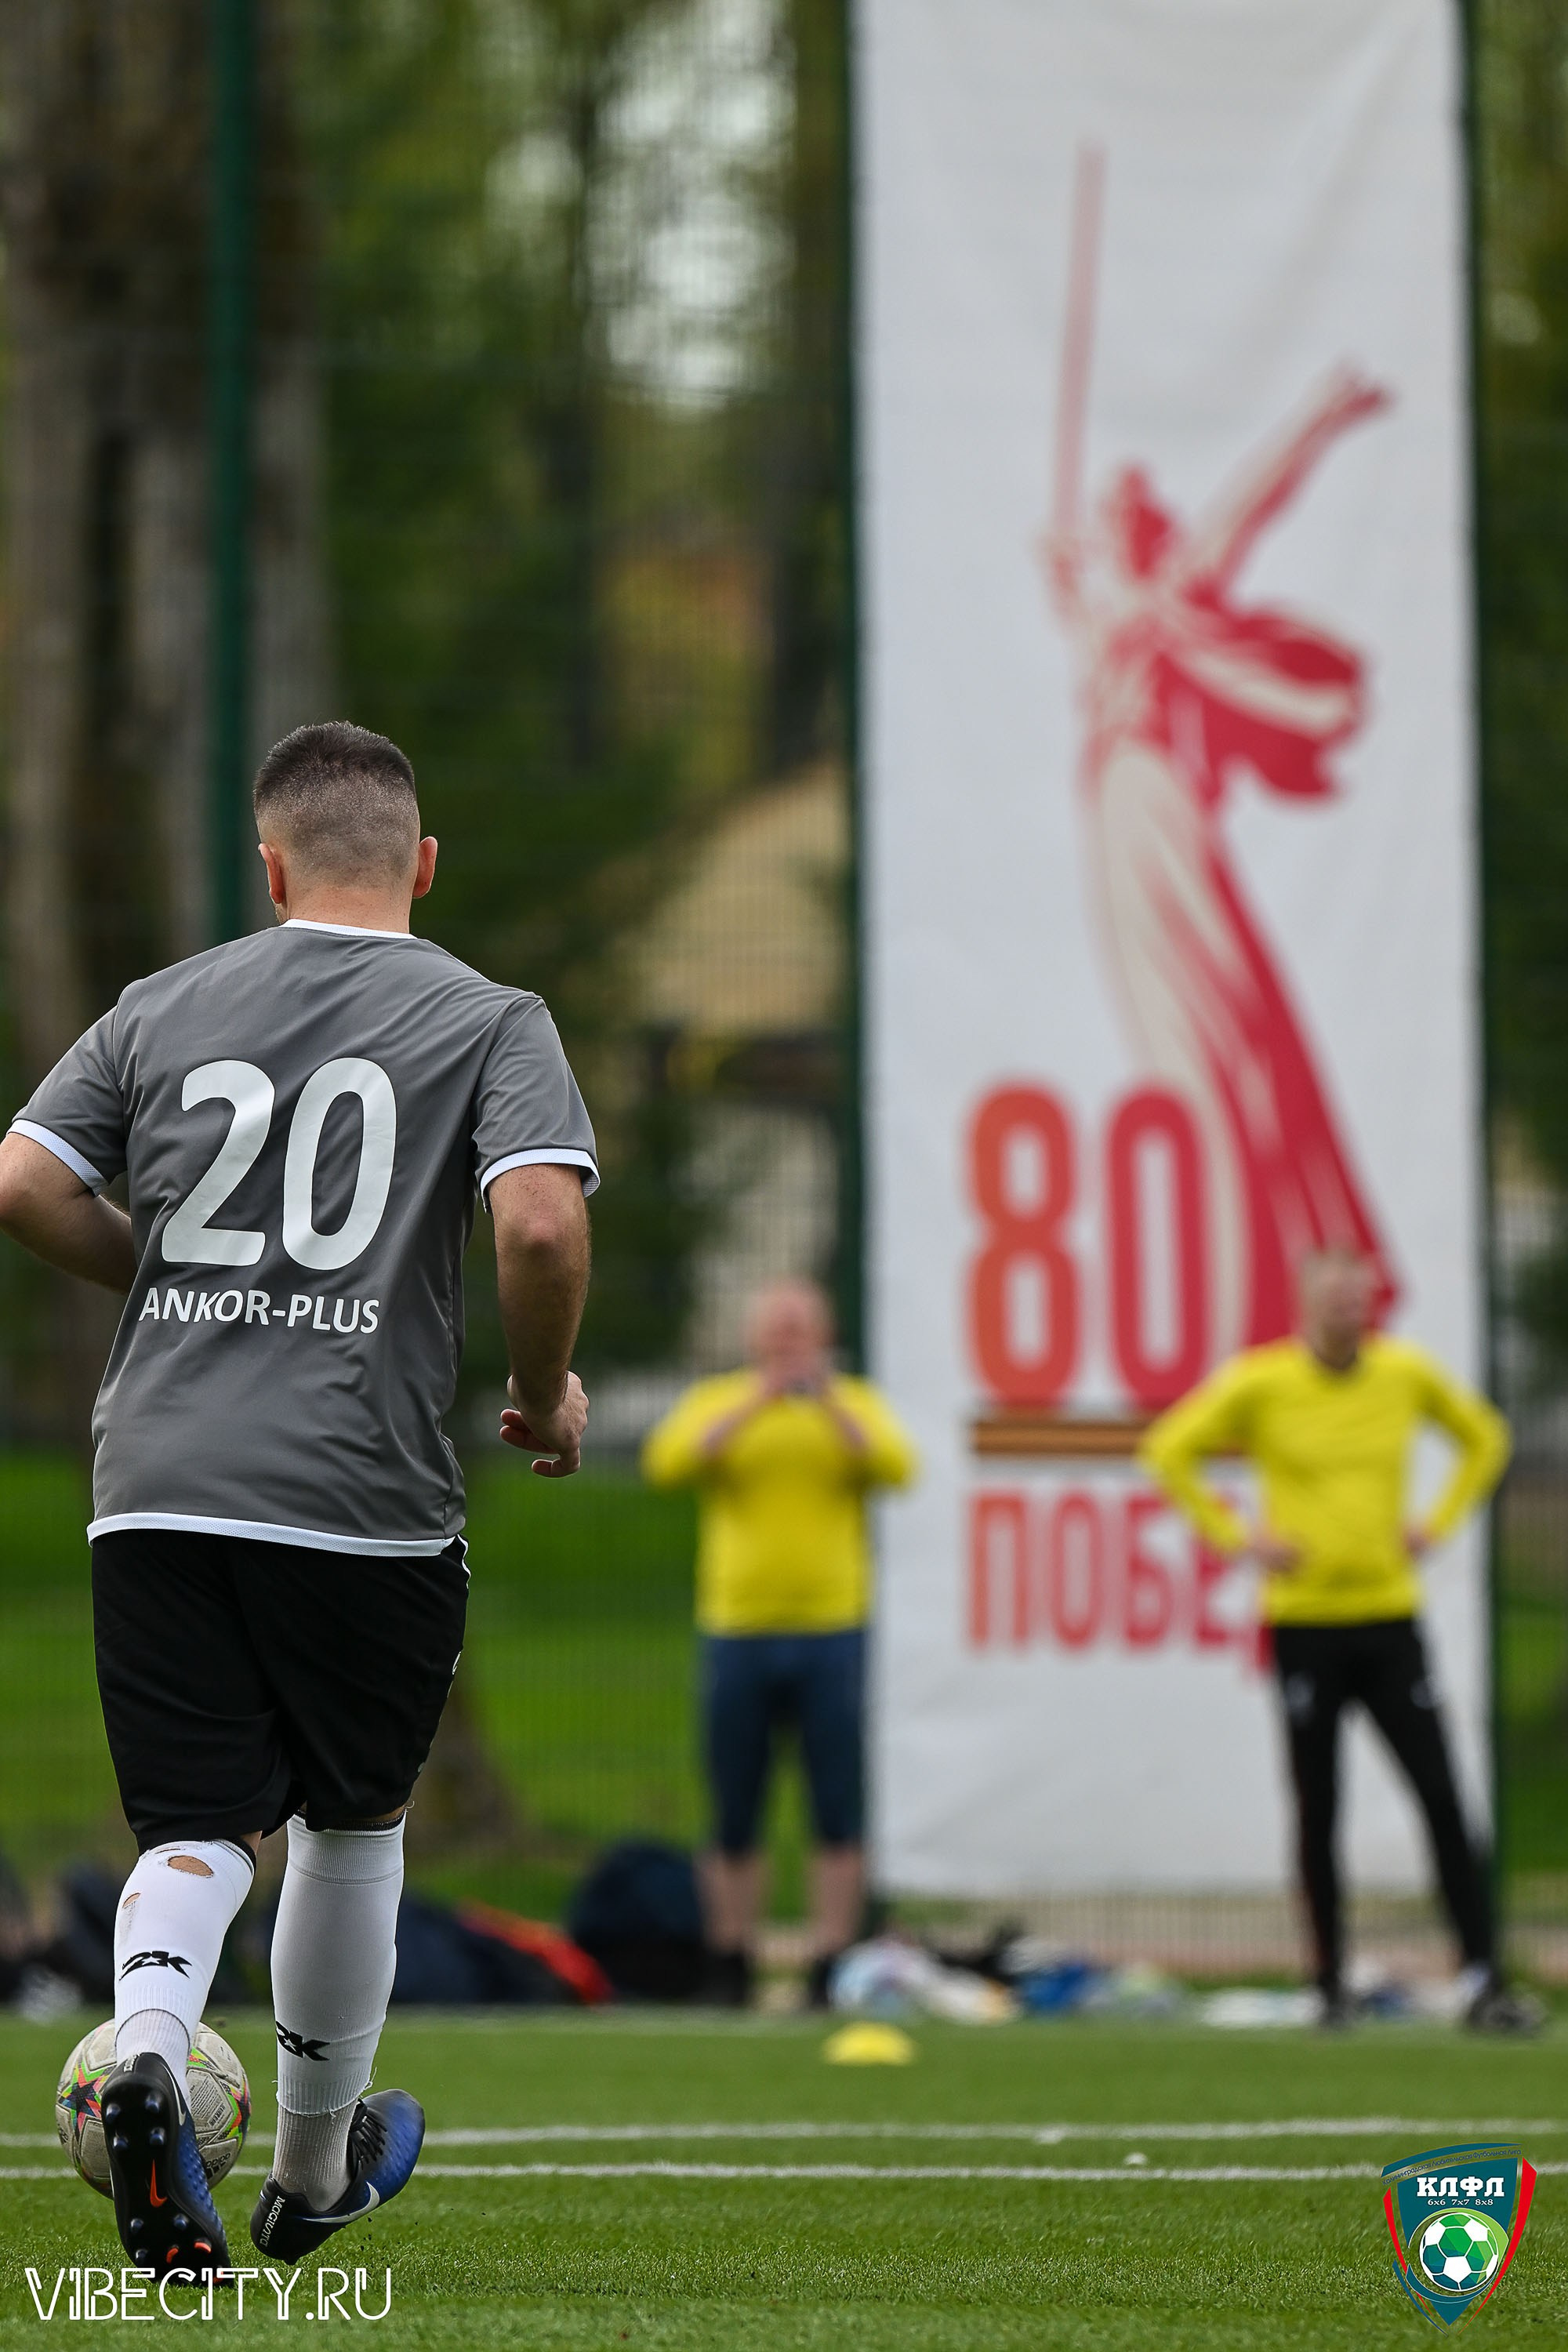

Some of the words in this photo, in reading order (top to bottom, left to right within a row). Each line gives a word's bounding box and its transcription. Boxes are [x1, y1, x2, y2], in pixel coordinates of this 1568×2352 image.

[162, 1057, 397, 1271] 20
[967, 1083, 1210, 1416] 80
[139, 1287, 380, 1334] ANKOR-PLUS
[970, 1492, 1275, 1674] ПОБЕ
